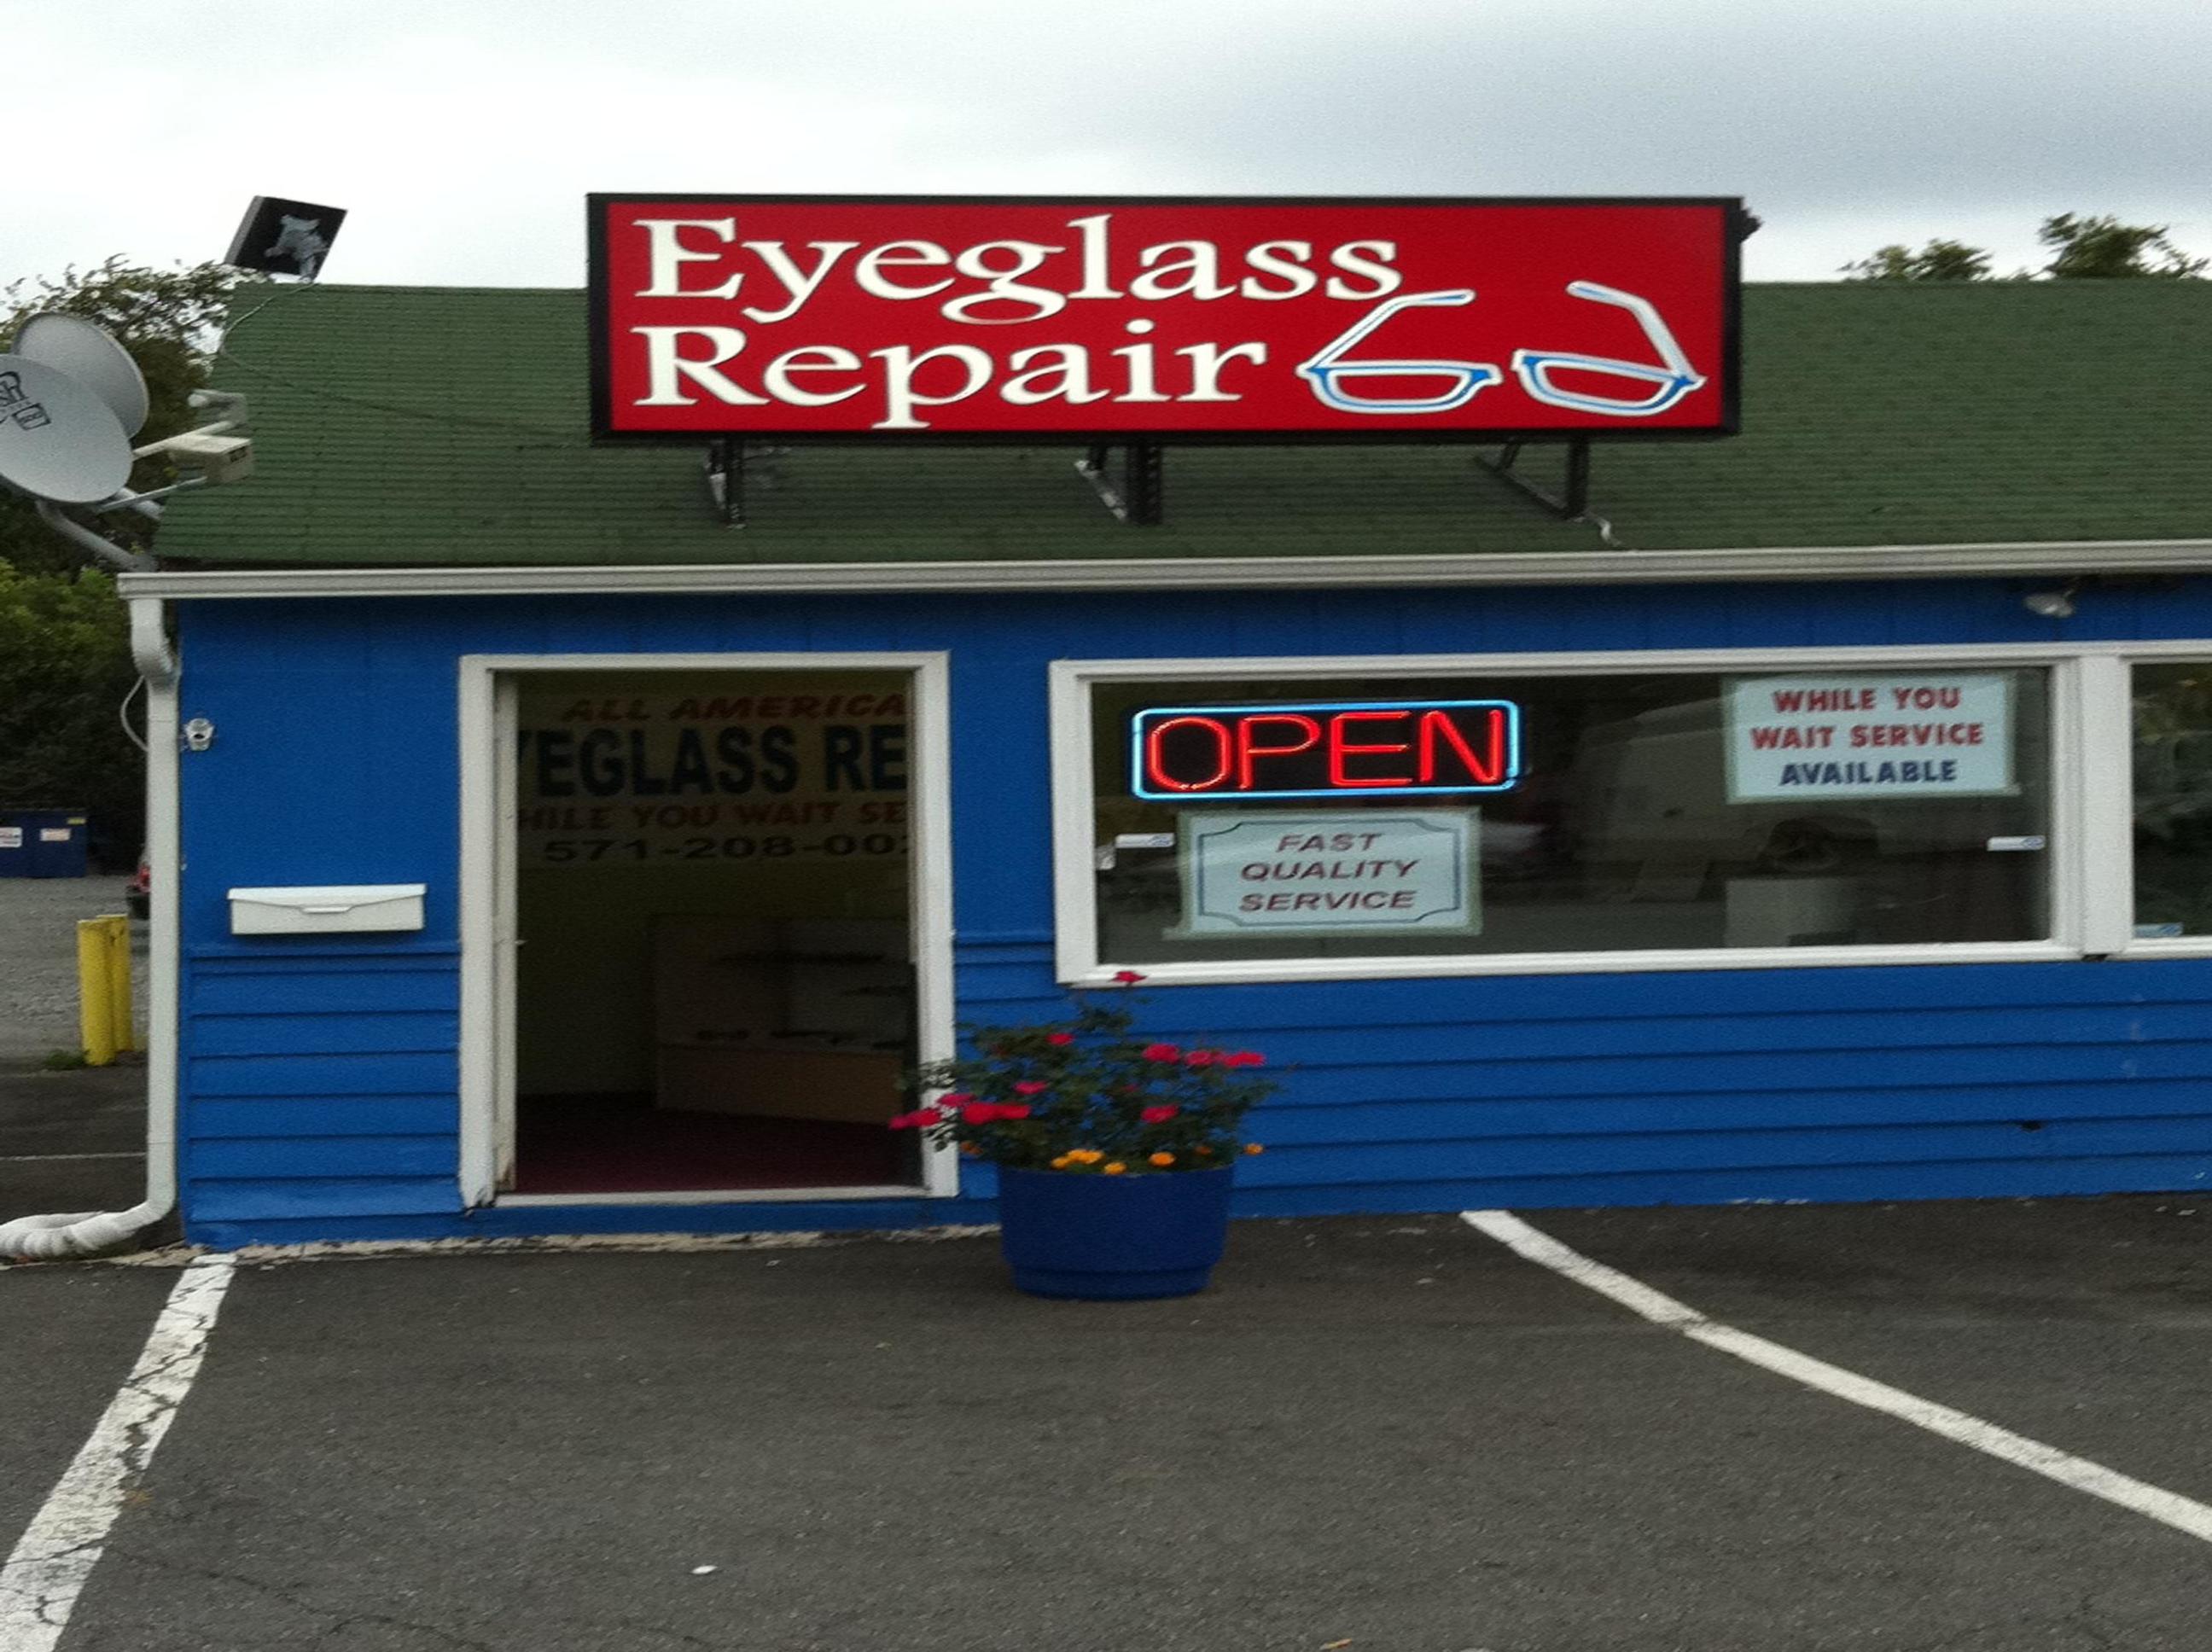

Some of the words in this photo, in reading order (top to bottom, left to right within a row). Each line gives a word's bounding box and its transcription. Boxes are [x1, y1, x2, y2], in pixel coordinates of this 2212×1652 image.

[632, 214, 1402, 324] Eyeglass
[630, 319, 1266, 429] Repair
[562, 699, 650, 721] ALL
[669, 694, 905, 718] AMERICA
[1774, 689, 1874, 712] WHILE
[1894, 688, 1961, 708] YOU
[1751, 725, 1834, 748] WAIT
[1851, 723, 1982, 747] SERVICE
[1147, 710, 1503, 791] OPEN
[1780, 760, 1957, 785] AVAILABLE
[518, 805, 611, 831] HILE
[635, 804, 718, 828] YOU
[733, 801, 841, 825] WAIT
[1278, 833, 1384, 852] FAST
[1242, 859, 1420, 881] QUALITY
[1239, 890, 1416, 911] SERVICE
